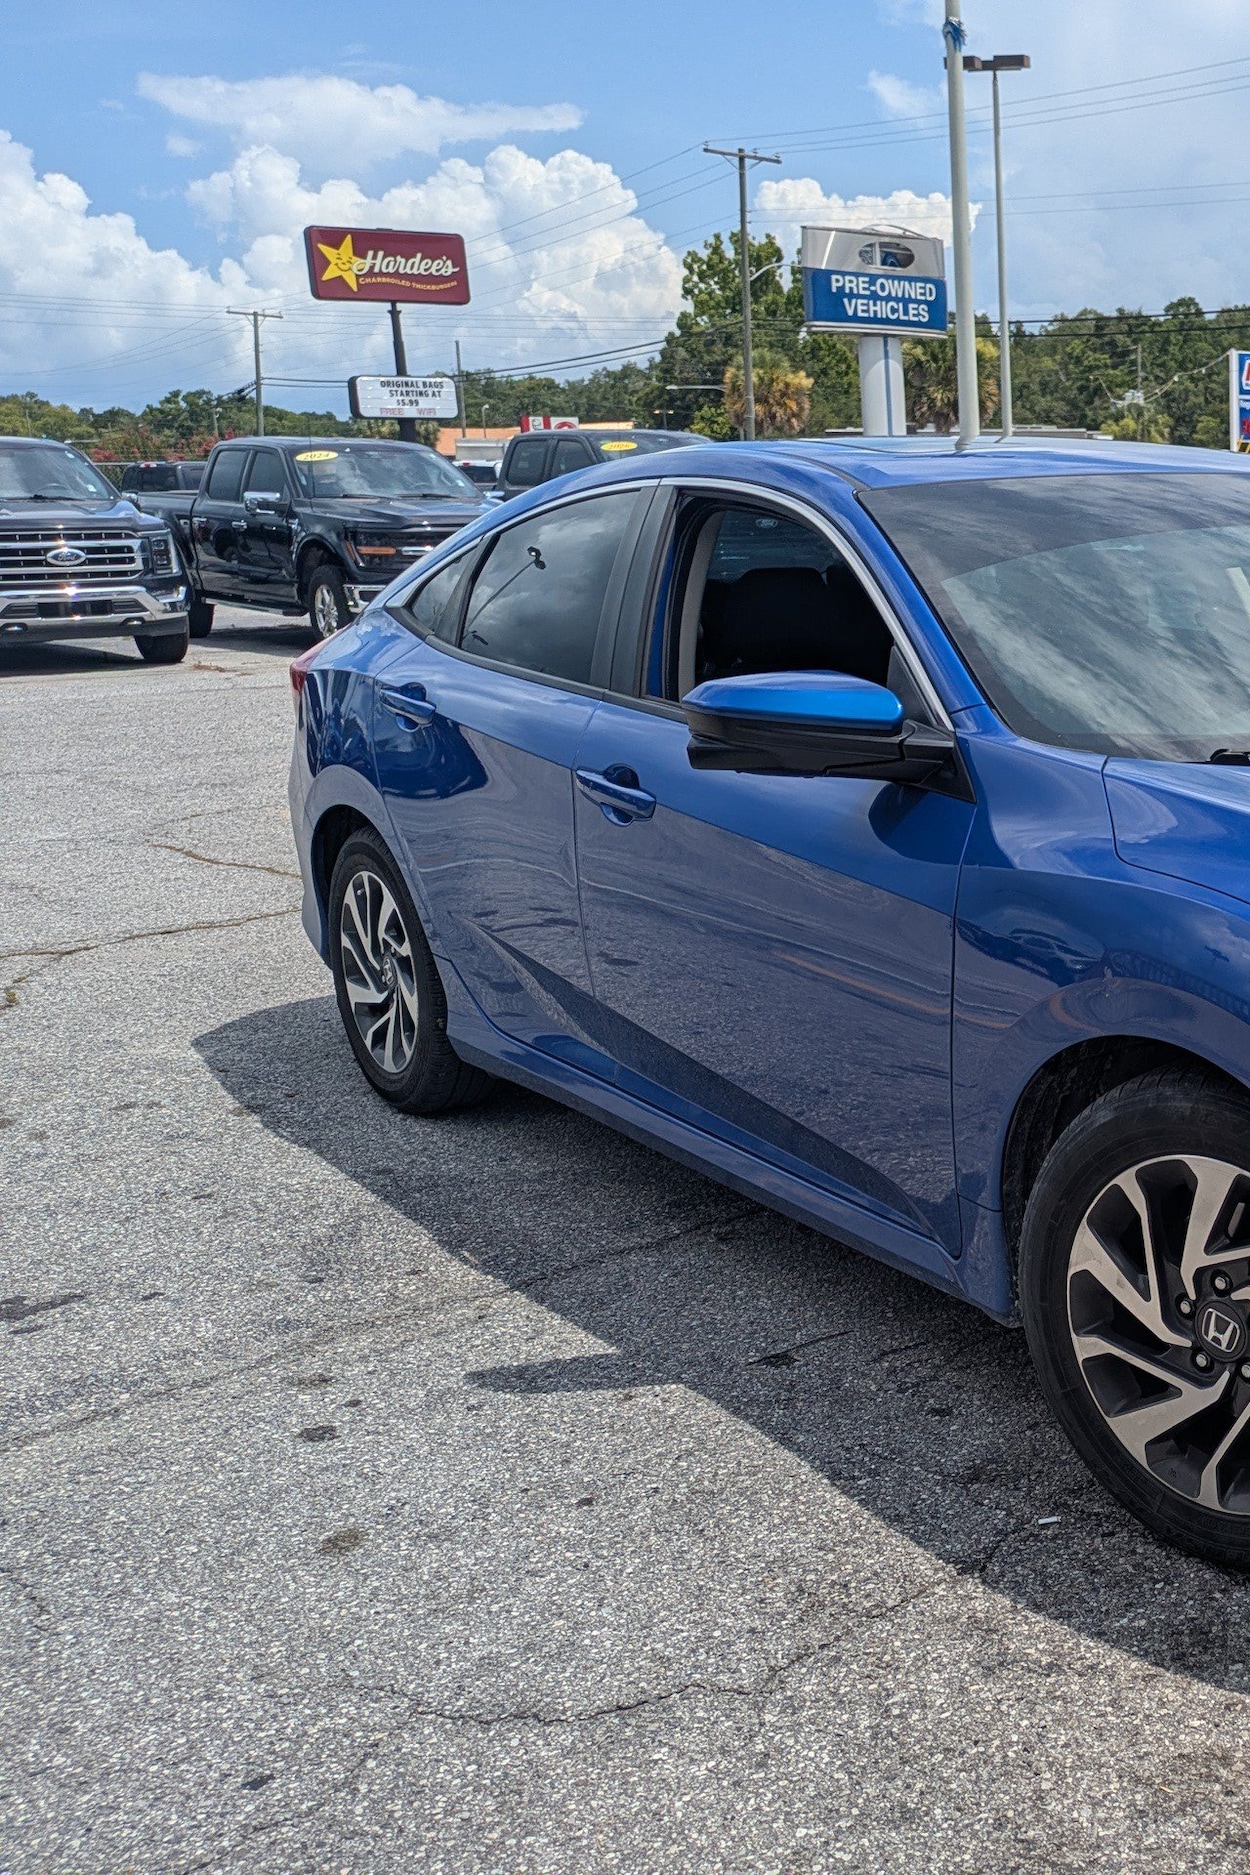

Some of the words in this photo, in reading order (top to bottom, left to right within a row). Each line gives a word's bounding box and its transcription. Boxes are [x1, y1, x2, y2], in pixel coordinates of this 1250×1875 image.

[352, 250, 460, 276] Hardee's
[830, 274, 937, 301] PRE-OWNED
[843, 298, 930, 323] VEHICLES
[380, 380, 420, 389] ORIGINAL
[422, 381, 444, 390] BAGS
[389, 389, 430, 398] STARTING
[431, 390, 442, 398] AT
[396, 399, 420, 407] $5.99
[380, 407, 404, 416] FREE
